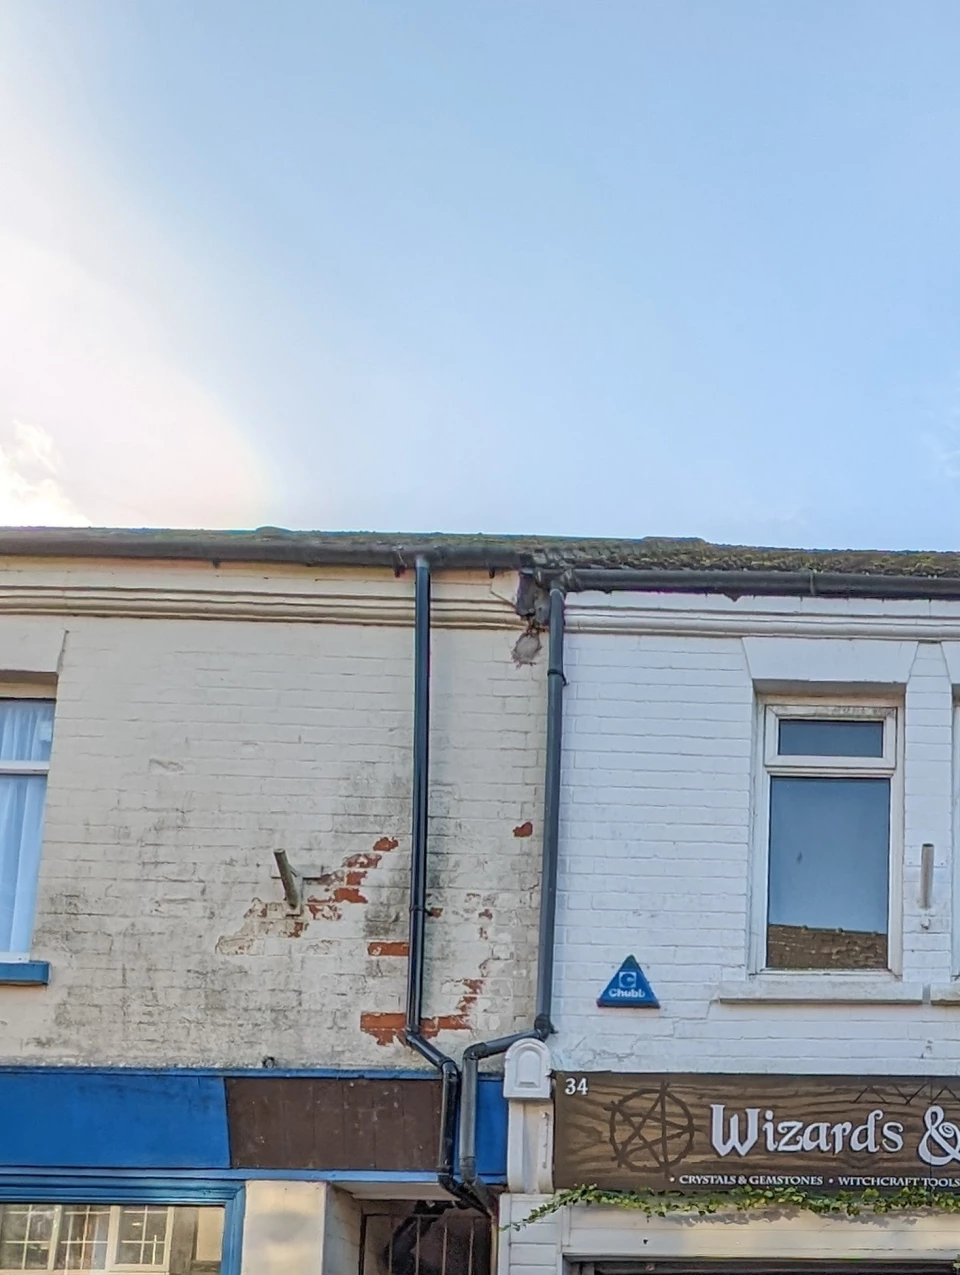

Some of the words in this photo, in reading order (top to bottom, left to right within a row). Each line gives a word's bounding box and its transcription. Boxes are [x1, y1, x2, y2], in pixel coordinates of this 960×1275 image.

[608, 988, 646, 998] Chubb
[565, 1078, 588, 1095] 34
[710, 1104, 905, 1158] Wizards
[679, 1175, 737, 1186] CRYSTALS
[738, 1175, 747, 1185] &
[749, 1175, 823, 1186] GEMSTONES
[838, 1176, 919, 1187] WITCHCRAFT
[921, 1177, 960, 1188] TOOLS
